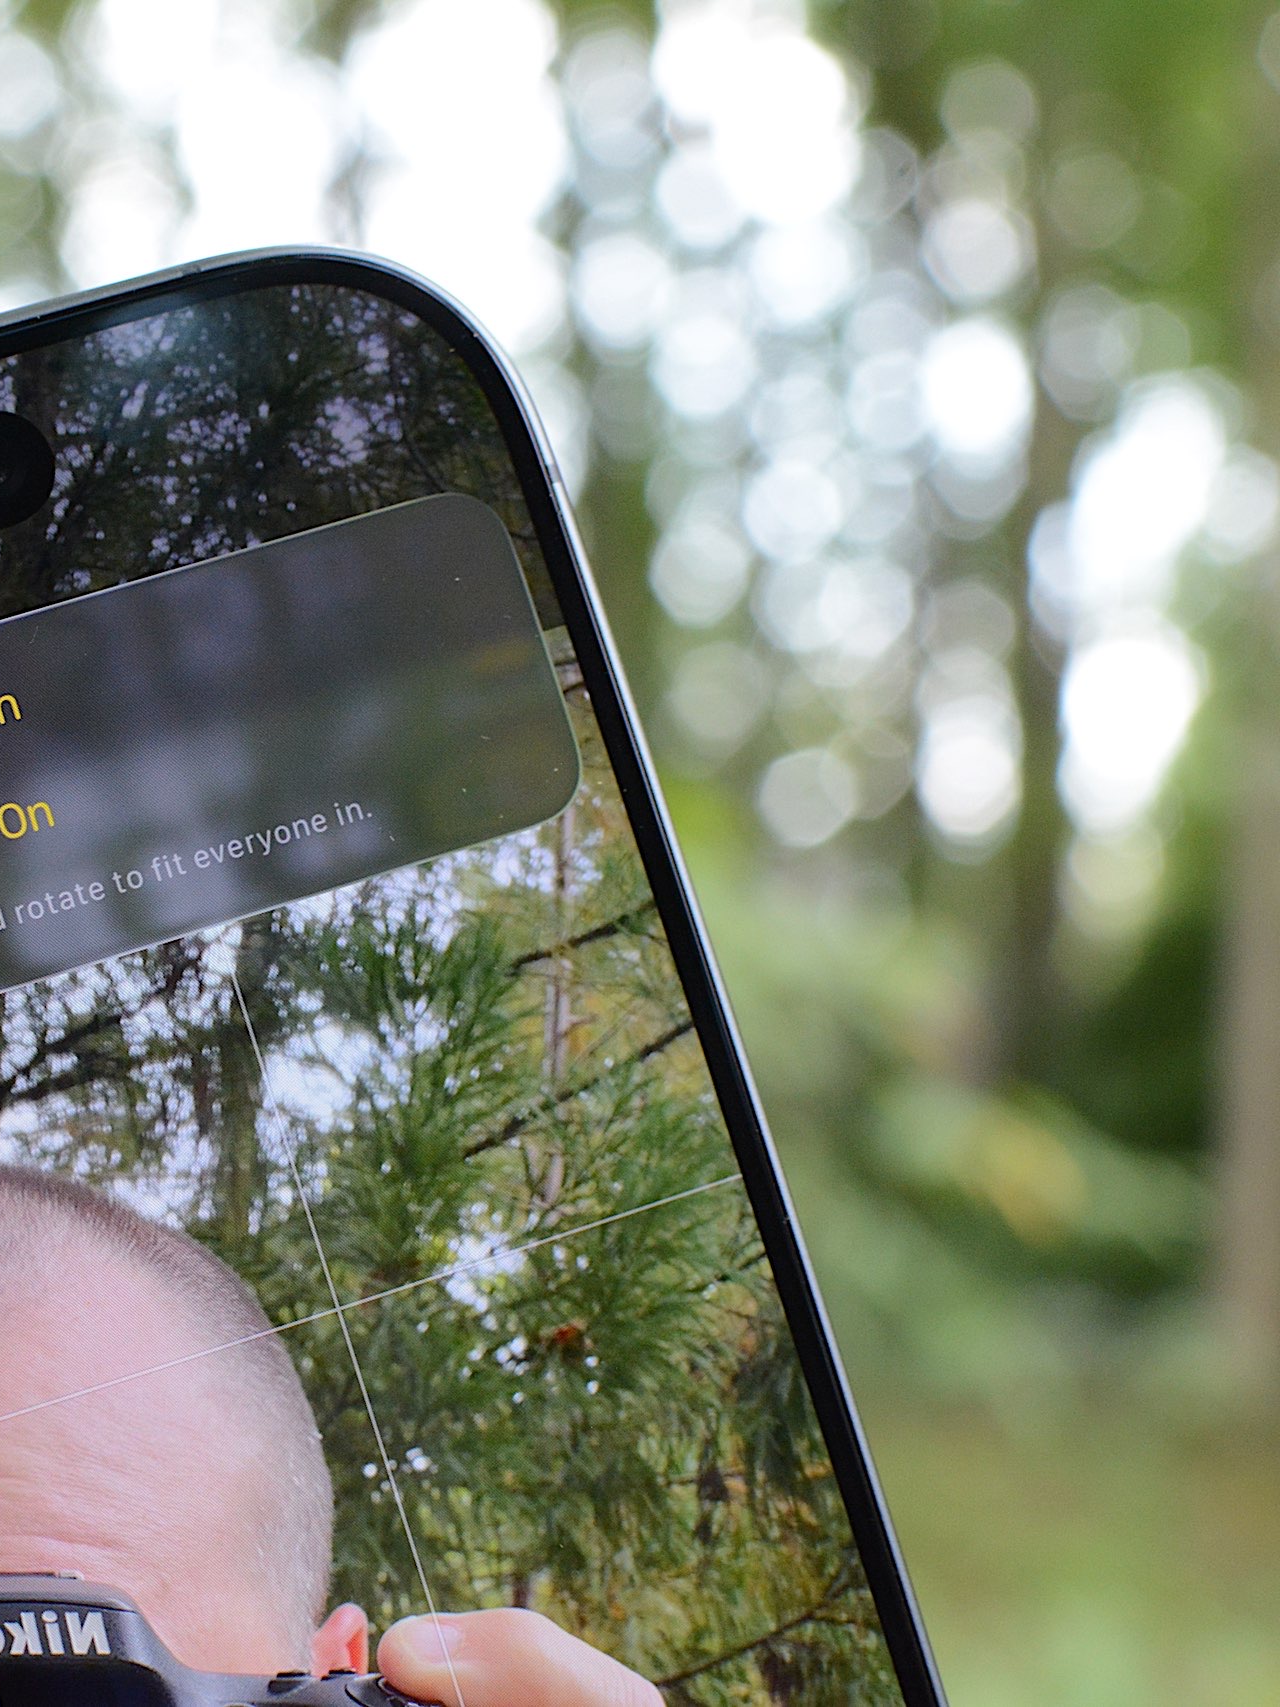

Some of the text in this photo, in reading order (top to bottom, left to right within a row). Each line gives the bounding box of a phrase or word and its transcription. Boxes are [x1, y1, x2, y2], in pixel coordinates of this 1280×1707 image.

[14, 880, 106, 924] rotate
[111, 869, 144, 895] to
[150, 853, 188, 885] fit
[194, 813, 328, 870] everyone
[334, 800, 374, 827] in.
